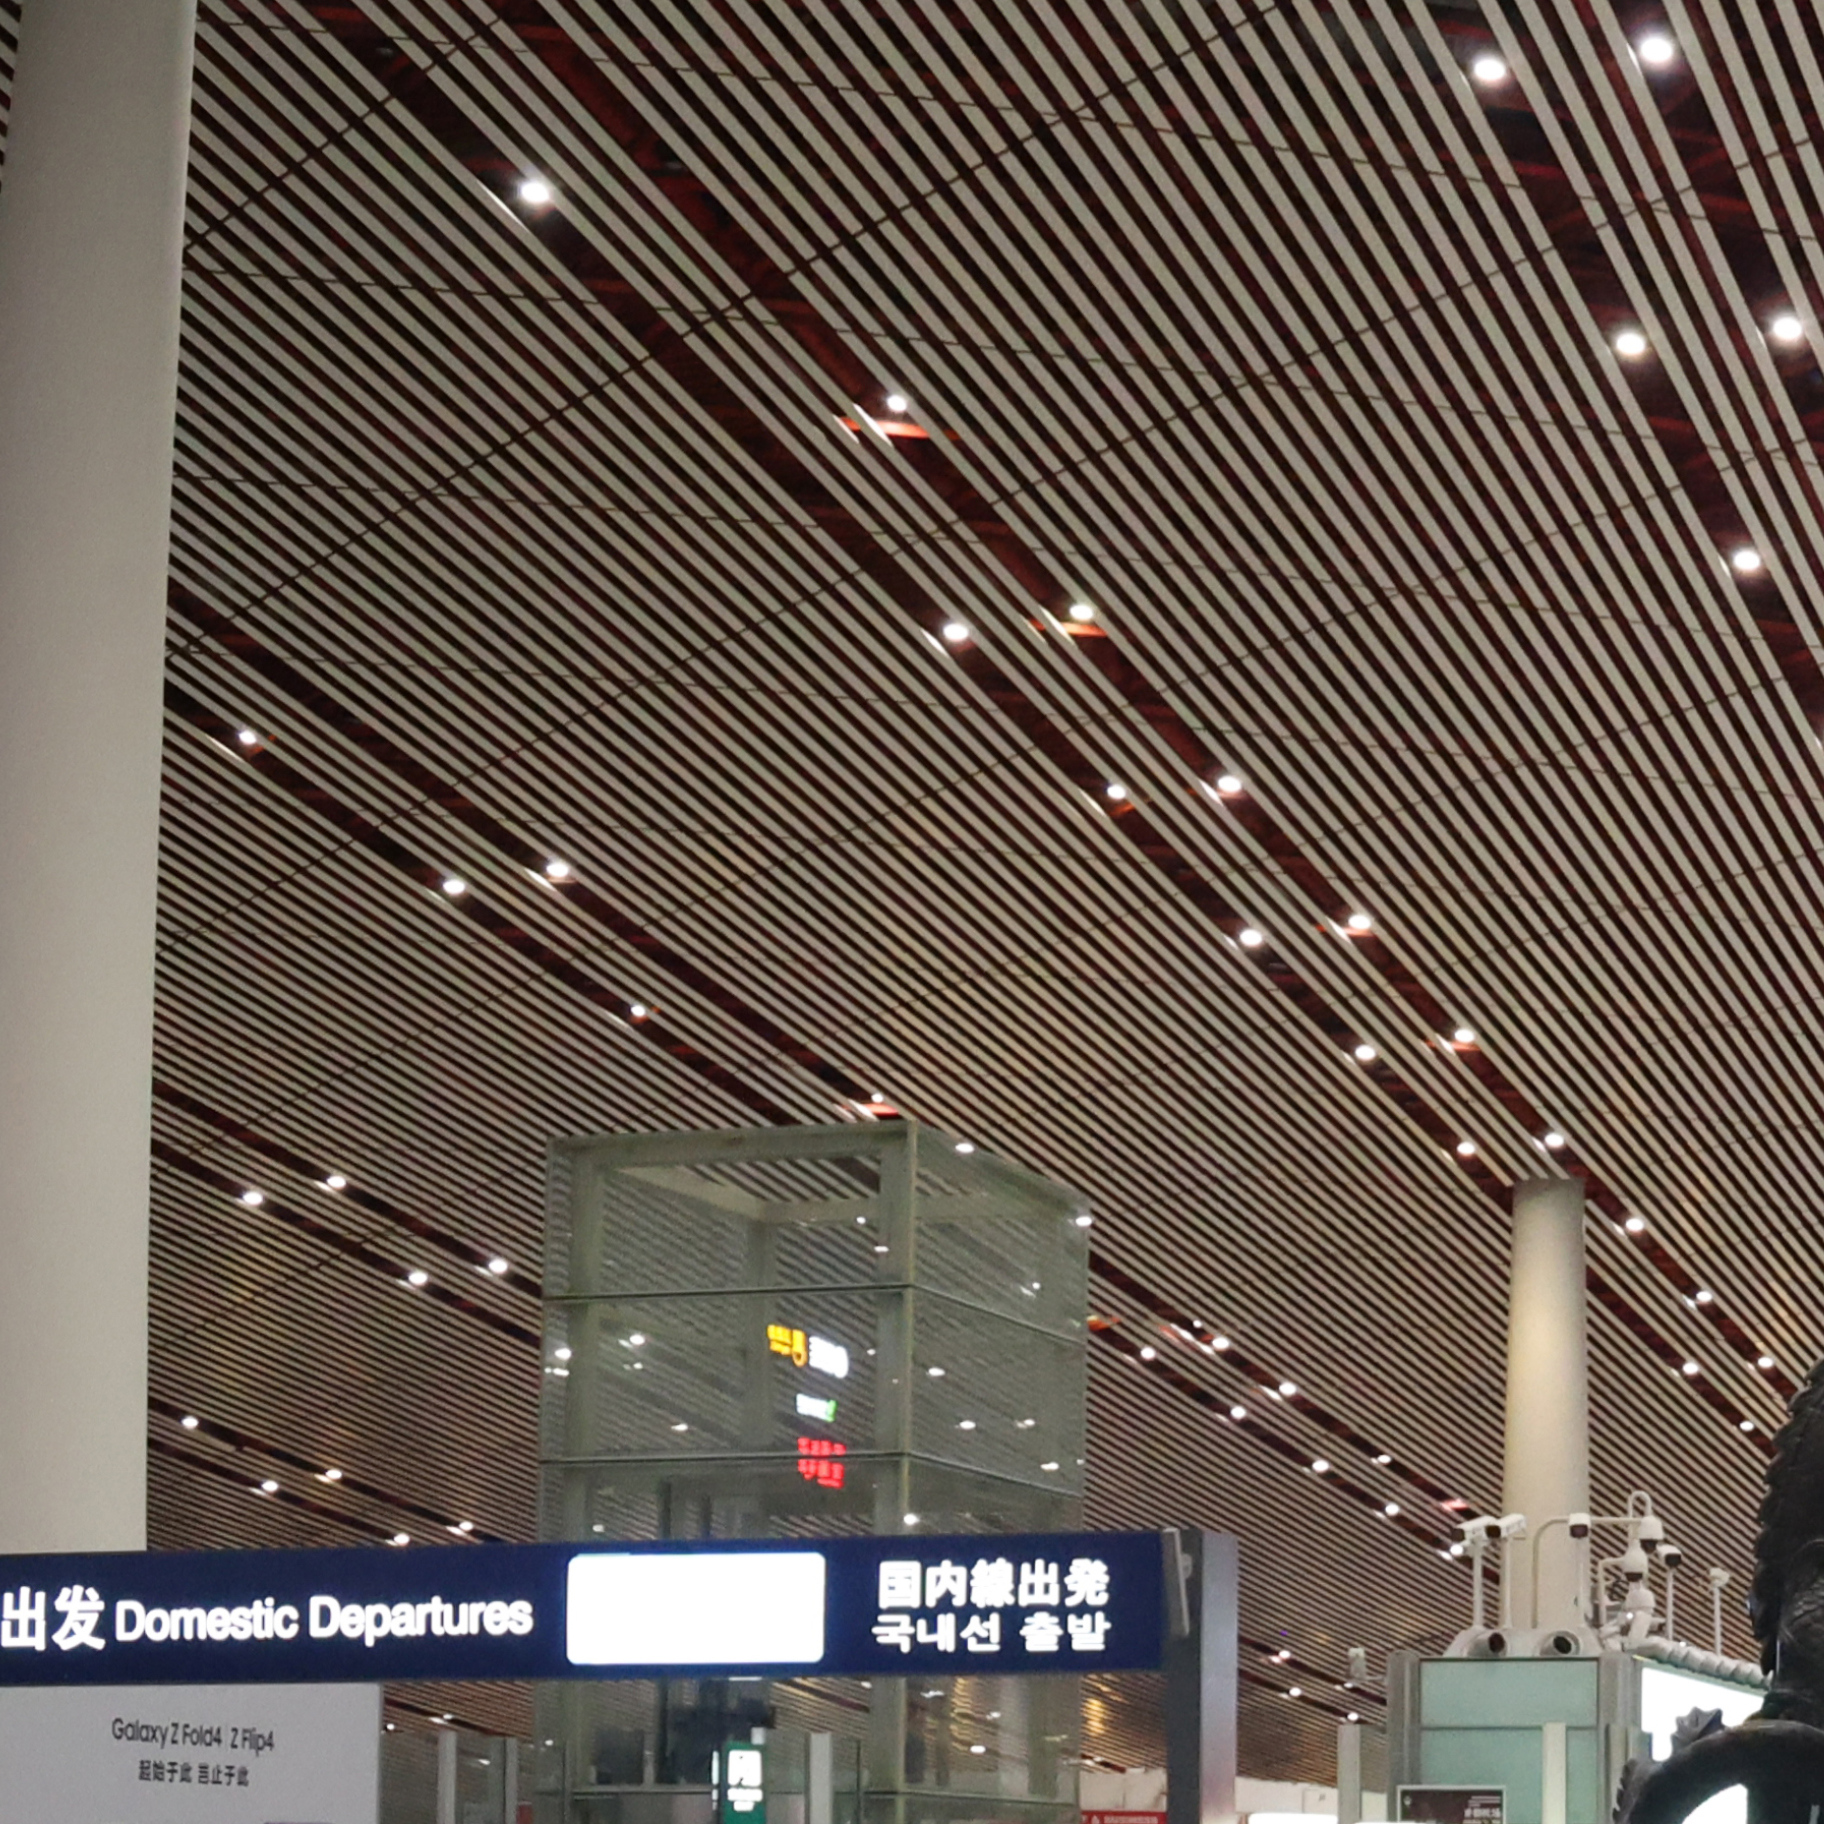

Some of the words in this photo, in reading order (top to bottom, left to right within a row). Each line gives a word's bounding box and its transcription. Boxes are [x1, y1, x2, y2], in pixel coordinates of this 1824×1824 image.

[879, 1557, 1110, 1609] 国内線出発
[0, 1586, 105, 1651] 出发
[115, 1597, 299, 1642] Domestic
[309, 1595, 533, 1646] Departures
[871, 1612, 1000, 1653] 국내선
[1019, 1611, 1112, 1652] 출발
[111, 1717, 168, 1749] Galaxy
[170, 1722, 180, 1745] Z
[182, 1724, 223, 1747] Fold4
[230, 1727, 239, 1749] Z
[241, 1728, 275, 1756] Flip4
